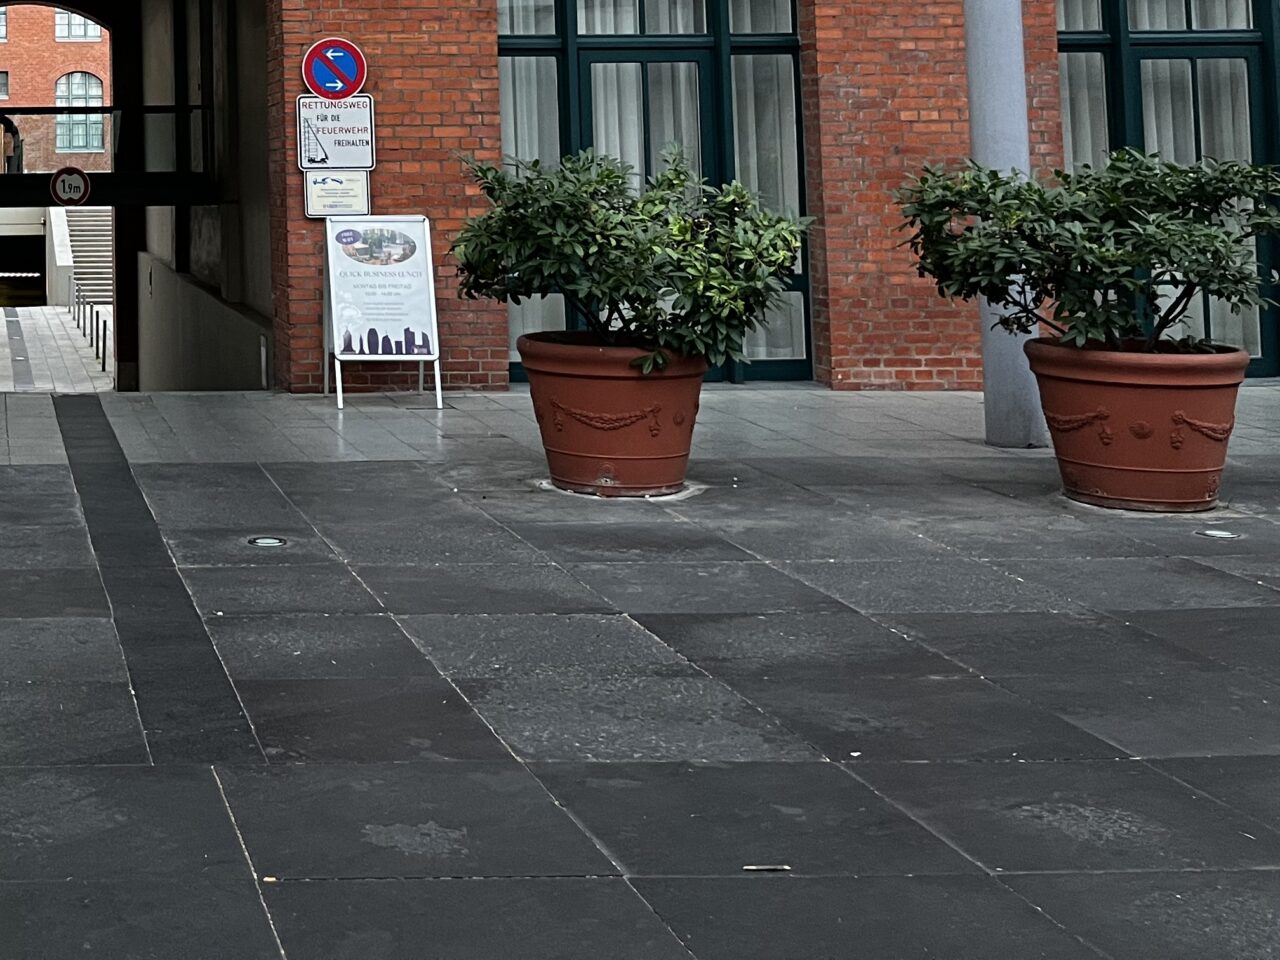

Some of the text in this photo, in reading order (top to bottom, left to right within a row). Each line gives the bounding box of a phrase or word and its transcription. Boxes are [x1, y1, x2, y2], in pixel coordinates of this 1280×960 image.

[302, 101, 368, 109] RETTUNGSWEG
[316, 113, 341, 122] FÜR DIE
[316, 126, 369, 135] FEUERWEHR
[334, 139, 370, 147] FREIHALTEN
